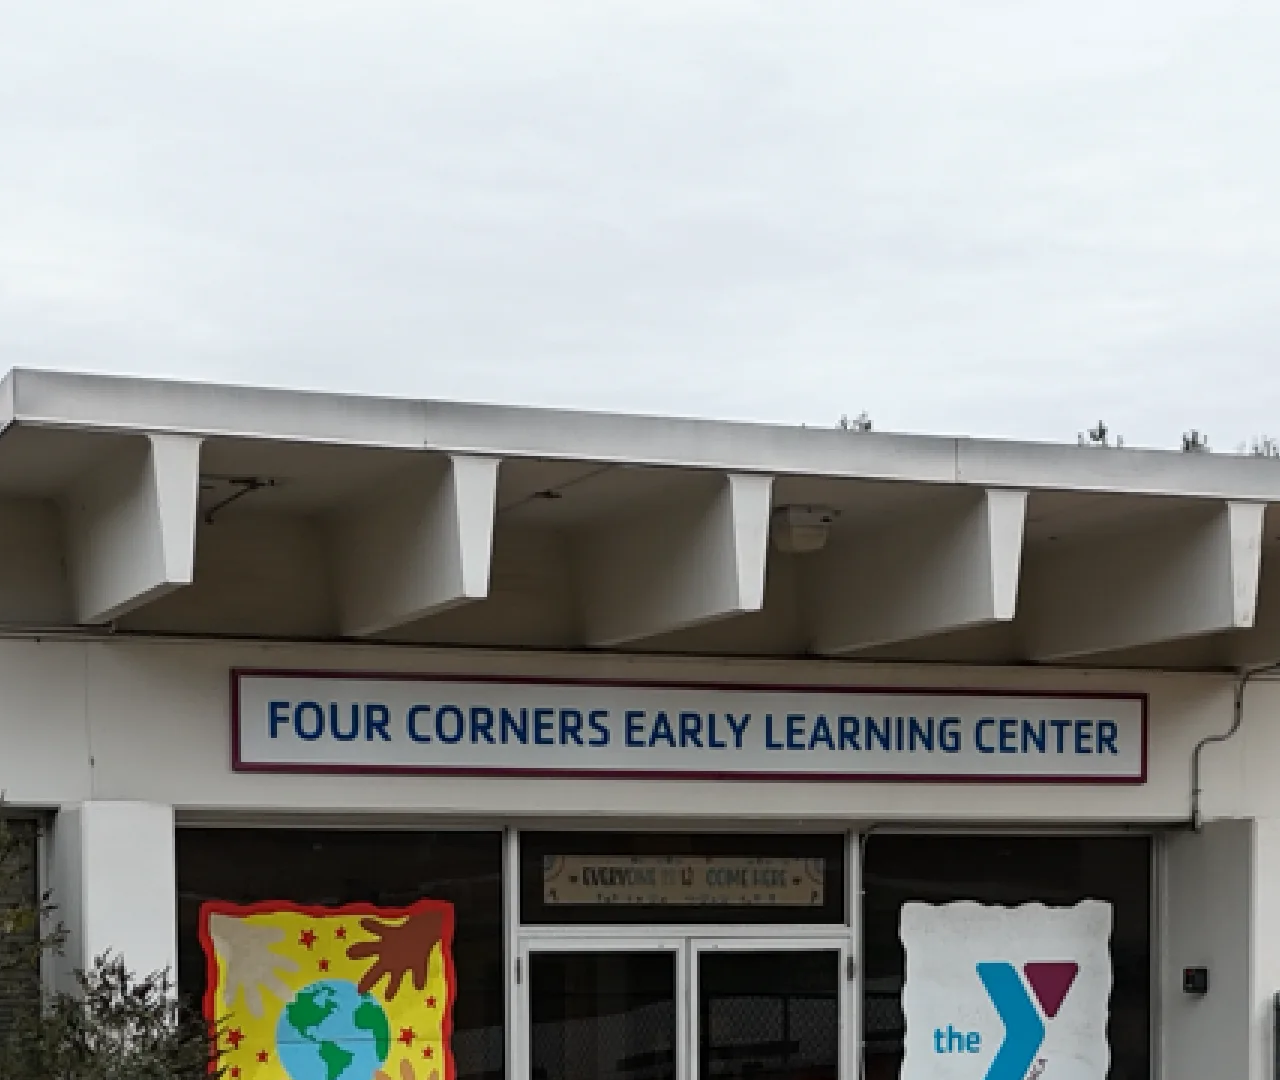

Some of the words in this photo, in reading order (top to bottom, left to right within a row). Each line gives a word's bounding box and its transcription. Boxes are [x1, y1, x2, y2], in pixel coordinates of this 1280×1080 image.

[268, 700, 391, 742] FOUR
[406, 704, 610, 746] CORNERS
[624, 711, 749, 749] EARLY
[765, 714, 961, 753] LEARNING
[975, 718, 1118, 754] CENTER
[933, 1023, 983, 1054] the
